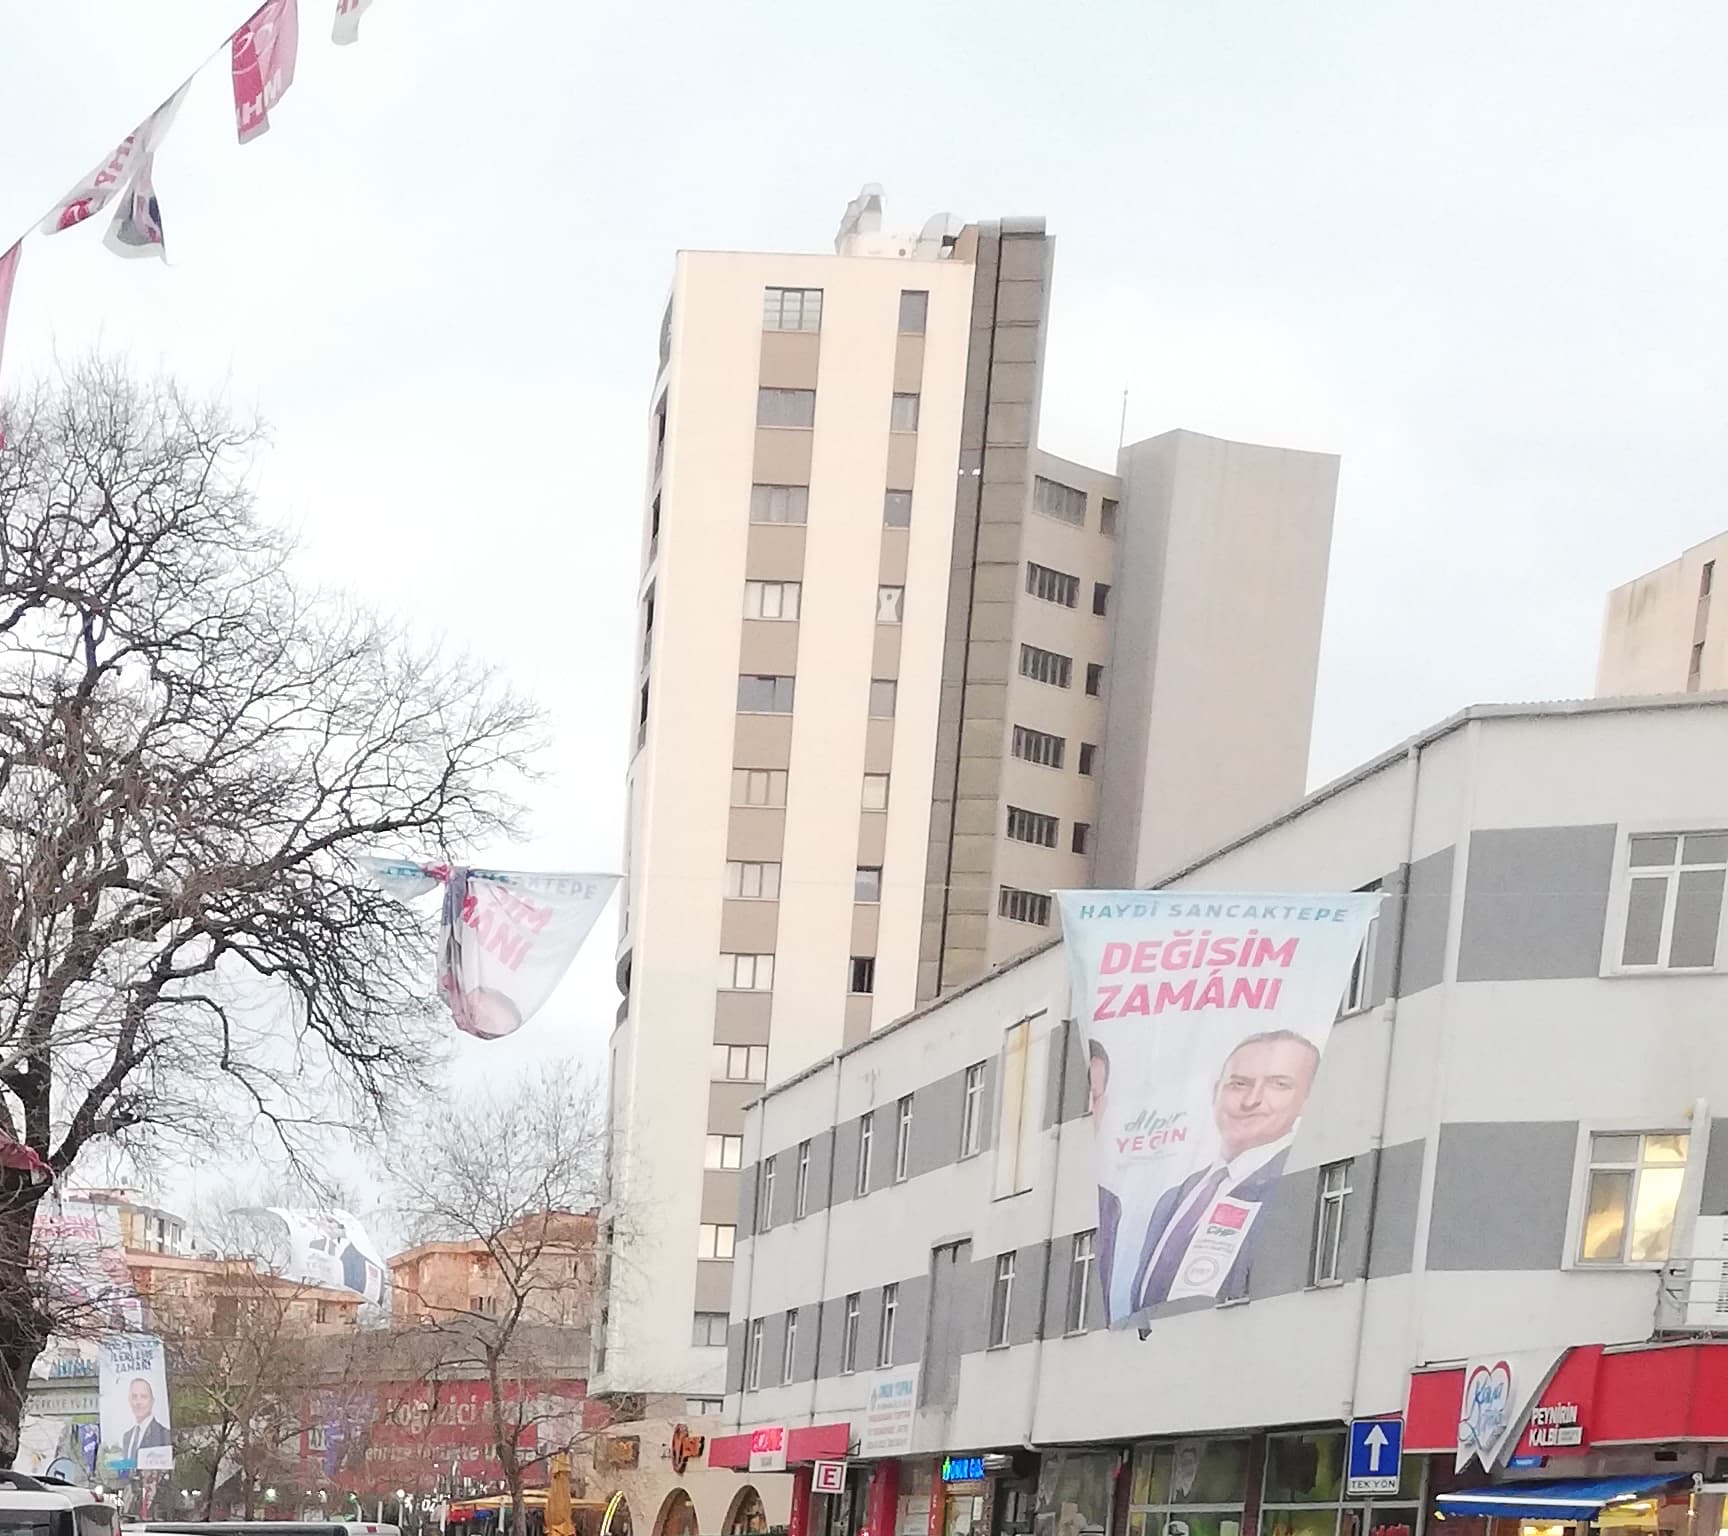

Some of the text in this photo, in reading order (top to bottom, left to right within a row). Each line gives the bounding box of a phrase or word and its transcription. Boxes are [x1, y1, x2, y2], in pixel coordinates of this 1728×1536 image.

[1079, 901, 1349, 923] HAYDİ SANCAKTEPE
[1093, 975, 1283, 1022] ZAMANI
[1531, 1402, 1579, 1427] PEYNİRİN
[1529, 1426, 1559, 1447] KALBİ
[823, 1469, 838, 1486] E
[1351, 1478, 1396, 1490] TEK YÖN
